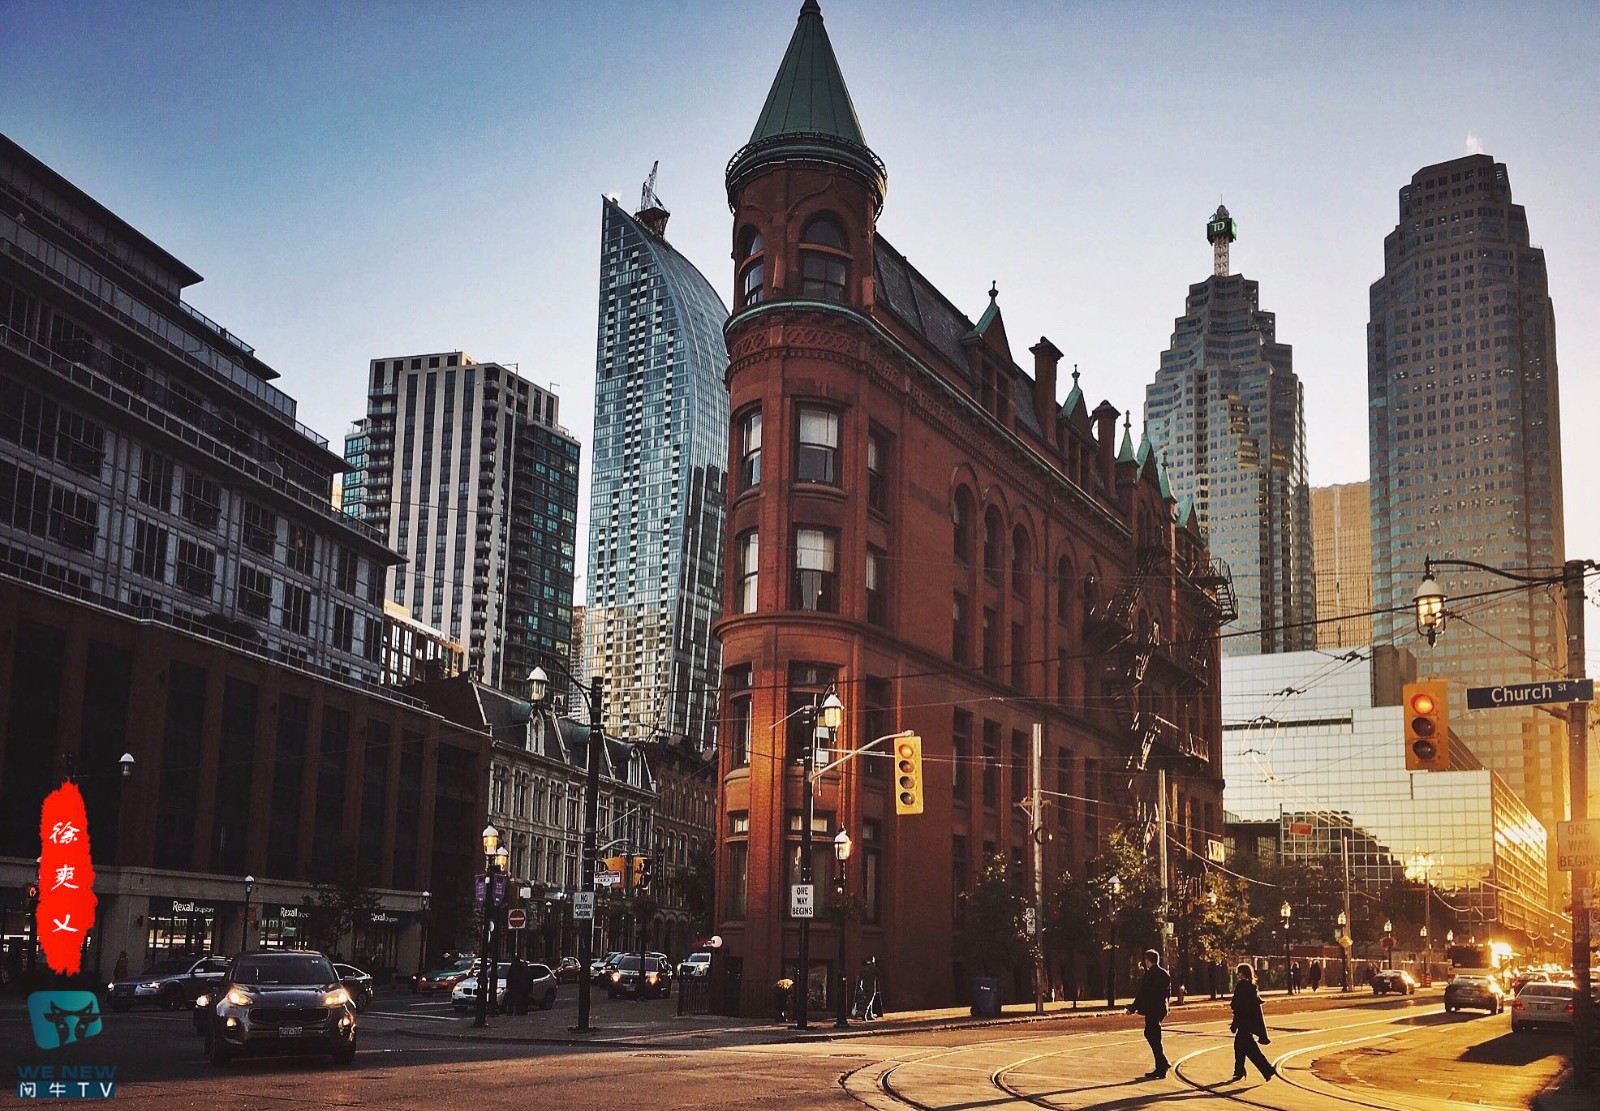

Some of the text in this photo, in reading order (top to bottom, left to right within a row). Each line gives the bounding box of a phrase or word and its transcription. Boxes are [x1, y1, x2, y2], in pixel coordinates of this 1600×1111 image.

[1211, 222, 1226, 232] TD
[1490, 683, 1567, 704] Church St
[1567, 823, 1591, 835] ONE
[1567, 839, 1590, 851] WAY
[1559, 854, 1600, 868] BEGINS
[796, 887, 808, 895] ONE
[580, 894, 589, 903] NO
[796, 897, 808, 905] WAY
[172, 900, 195, 912] Rexall
[280, 906, 298, 918] Rexall
[792, 907, 812, 915] BEGINS
